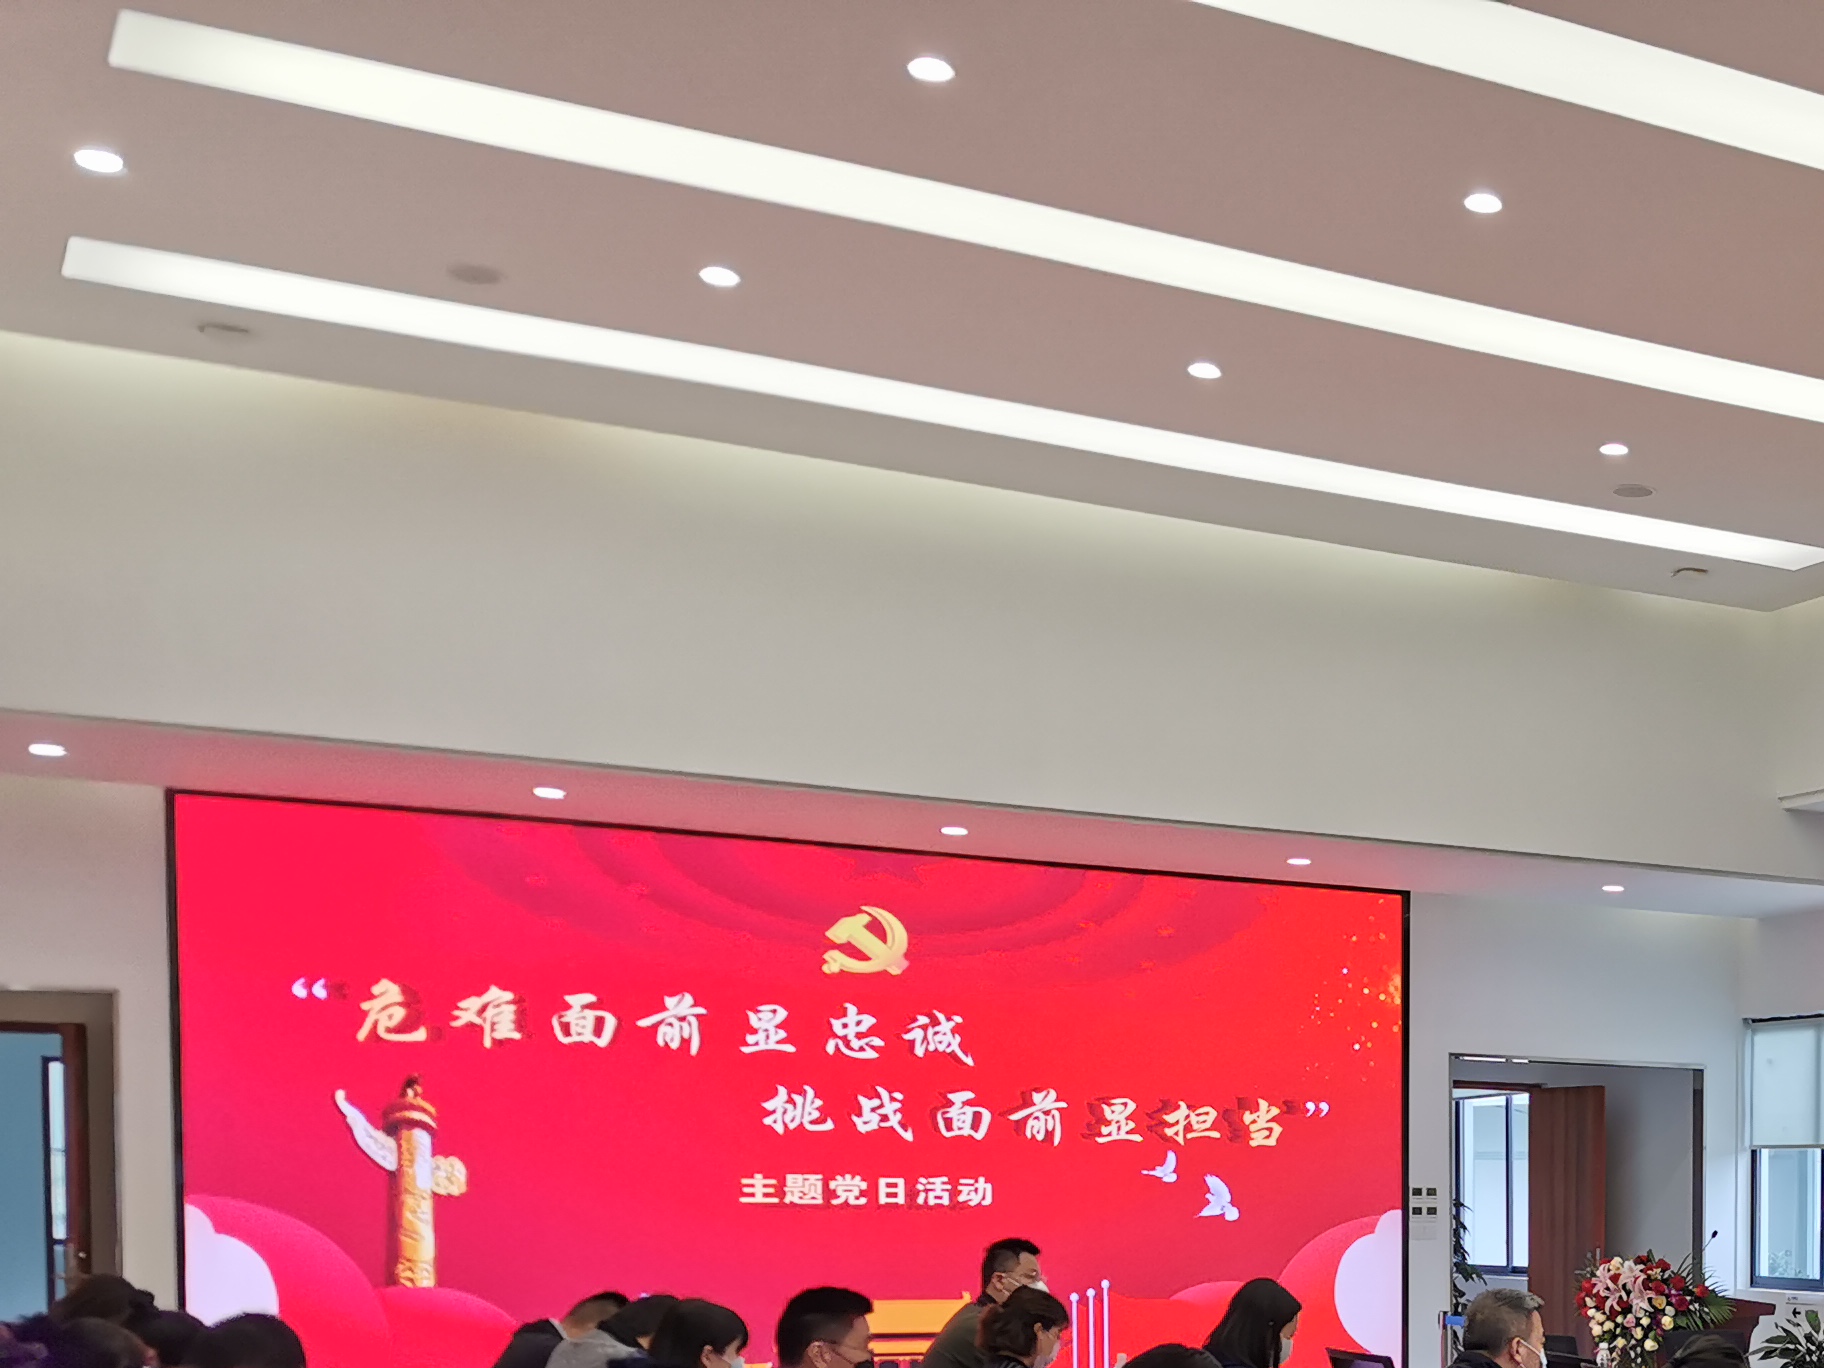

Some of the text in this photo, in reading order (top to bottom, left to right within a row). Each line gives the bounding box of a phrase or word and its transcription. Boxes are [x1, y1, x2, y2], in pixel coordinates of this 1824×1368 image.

[738, 1172, 995, 1209] 主题党日活动
